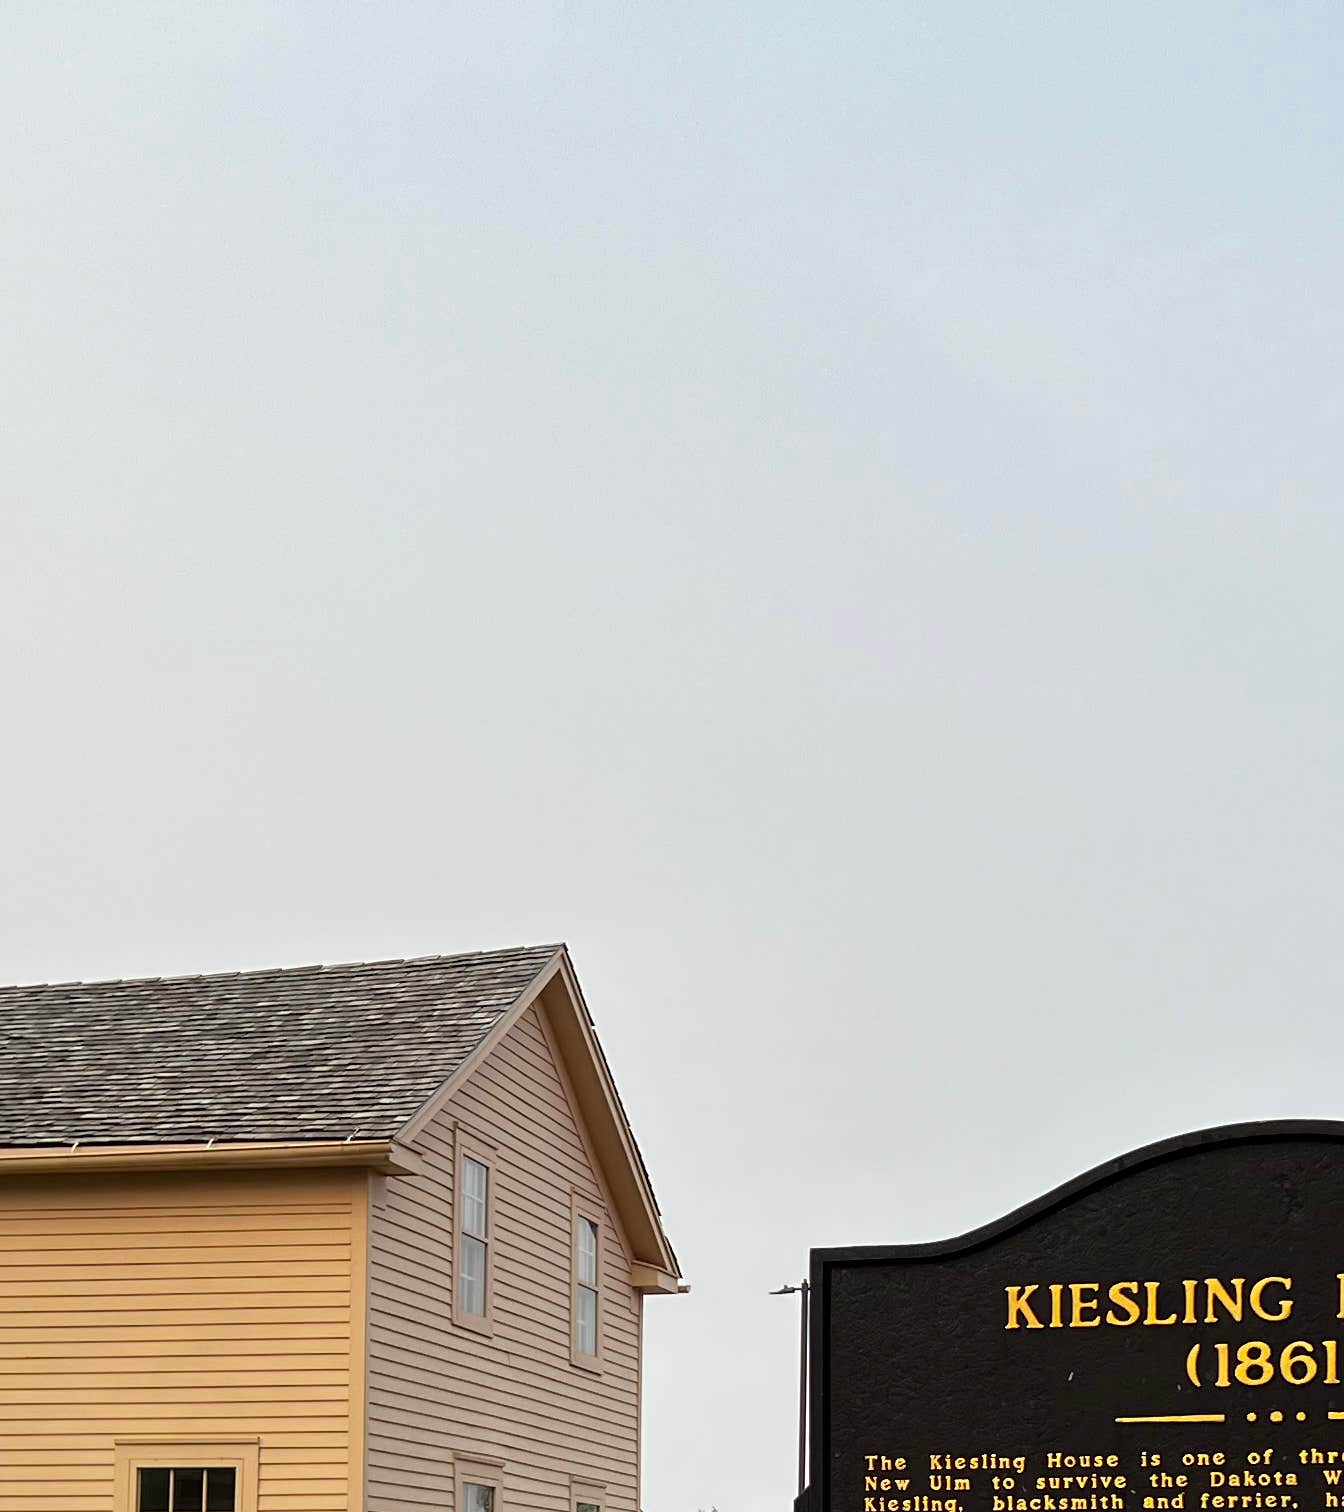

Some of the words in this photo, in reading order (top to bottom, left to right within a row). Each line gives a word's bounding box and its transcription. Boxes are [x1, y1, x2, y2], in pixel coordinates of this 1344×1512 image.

[1007, 1277, 1293, 1329] KIESLING
[864, 1454, 907, 1471] The
[929, 1453, 1026, 1474] Kiesling
[1047, 1452, 1119, 1469] House
[1140, 1451, 1161, 1467] is
[1181, 1452, 1226, 1466] one
[1247, 1448, 1274, 1465] of
[864, 1475, 911, 1492] New
[928, 1474, 971, 1491] Ulm
[991, 1476, 1015, 1491] to
[1035, 1473, 1127, 1490] survive
[1149, 1472, 1189, 1488] the
[1209, 1470, 1298, 1488] Dakota
[992, 1493, 1124, 1512] blacksmith
[1142, 1491, 1185, 1510] and
[1200, 1492, 1299, 1510] ferrier,
